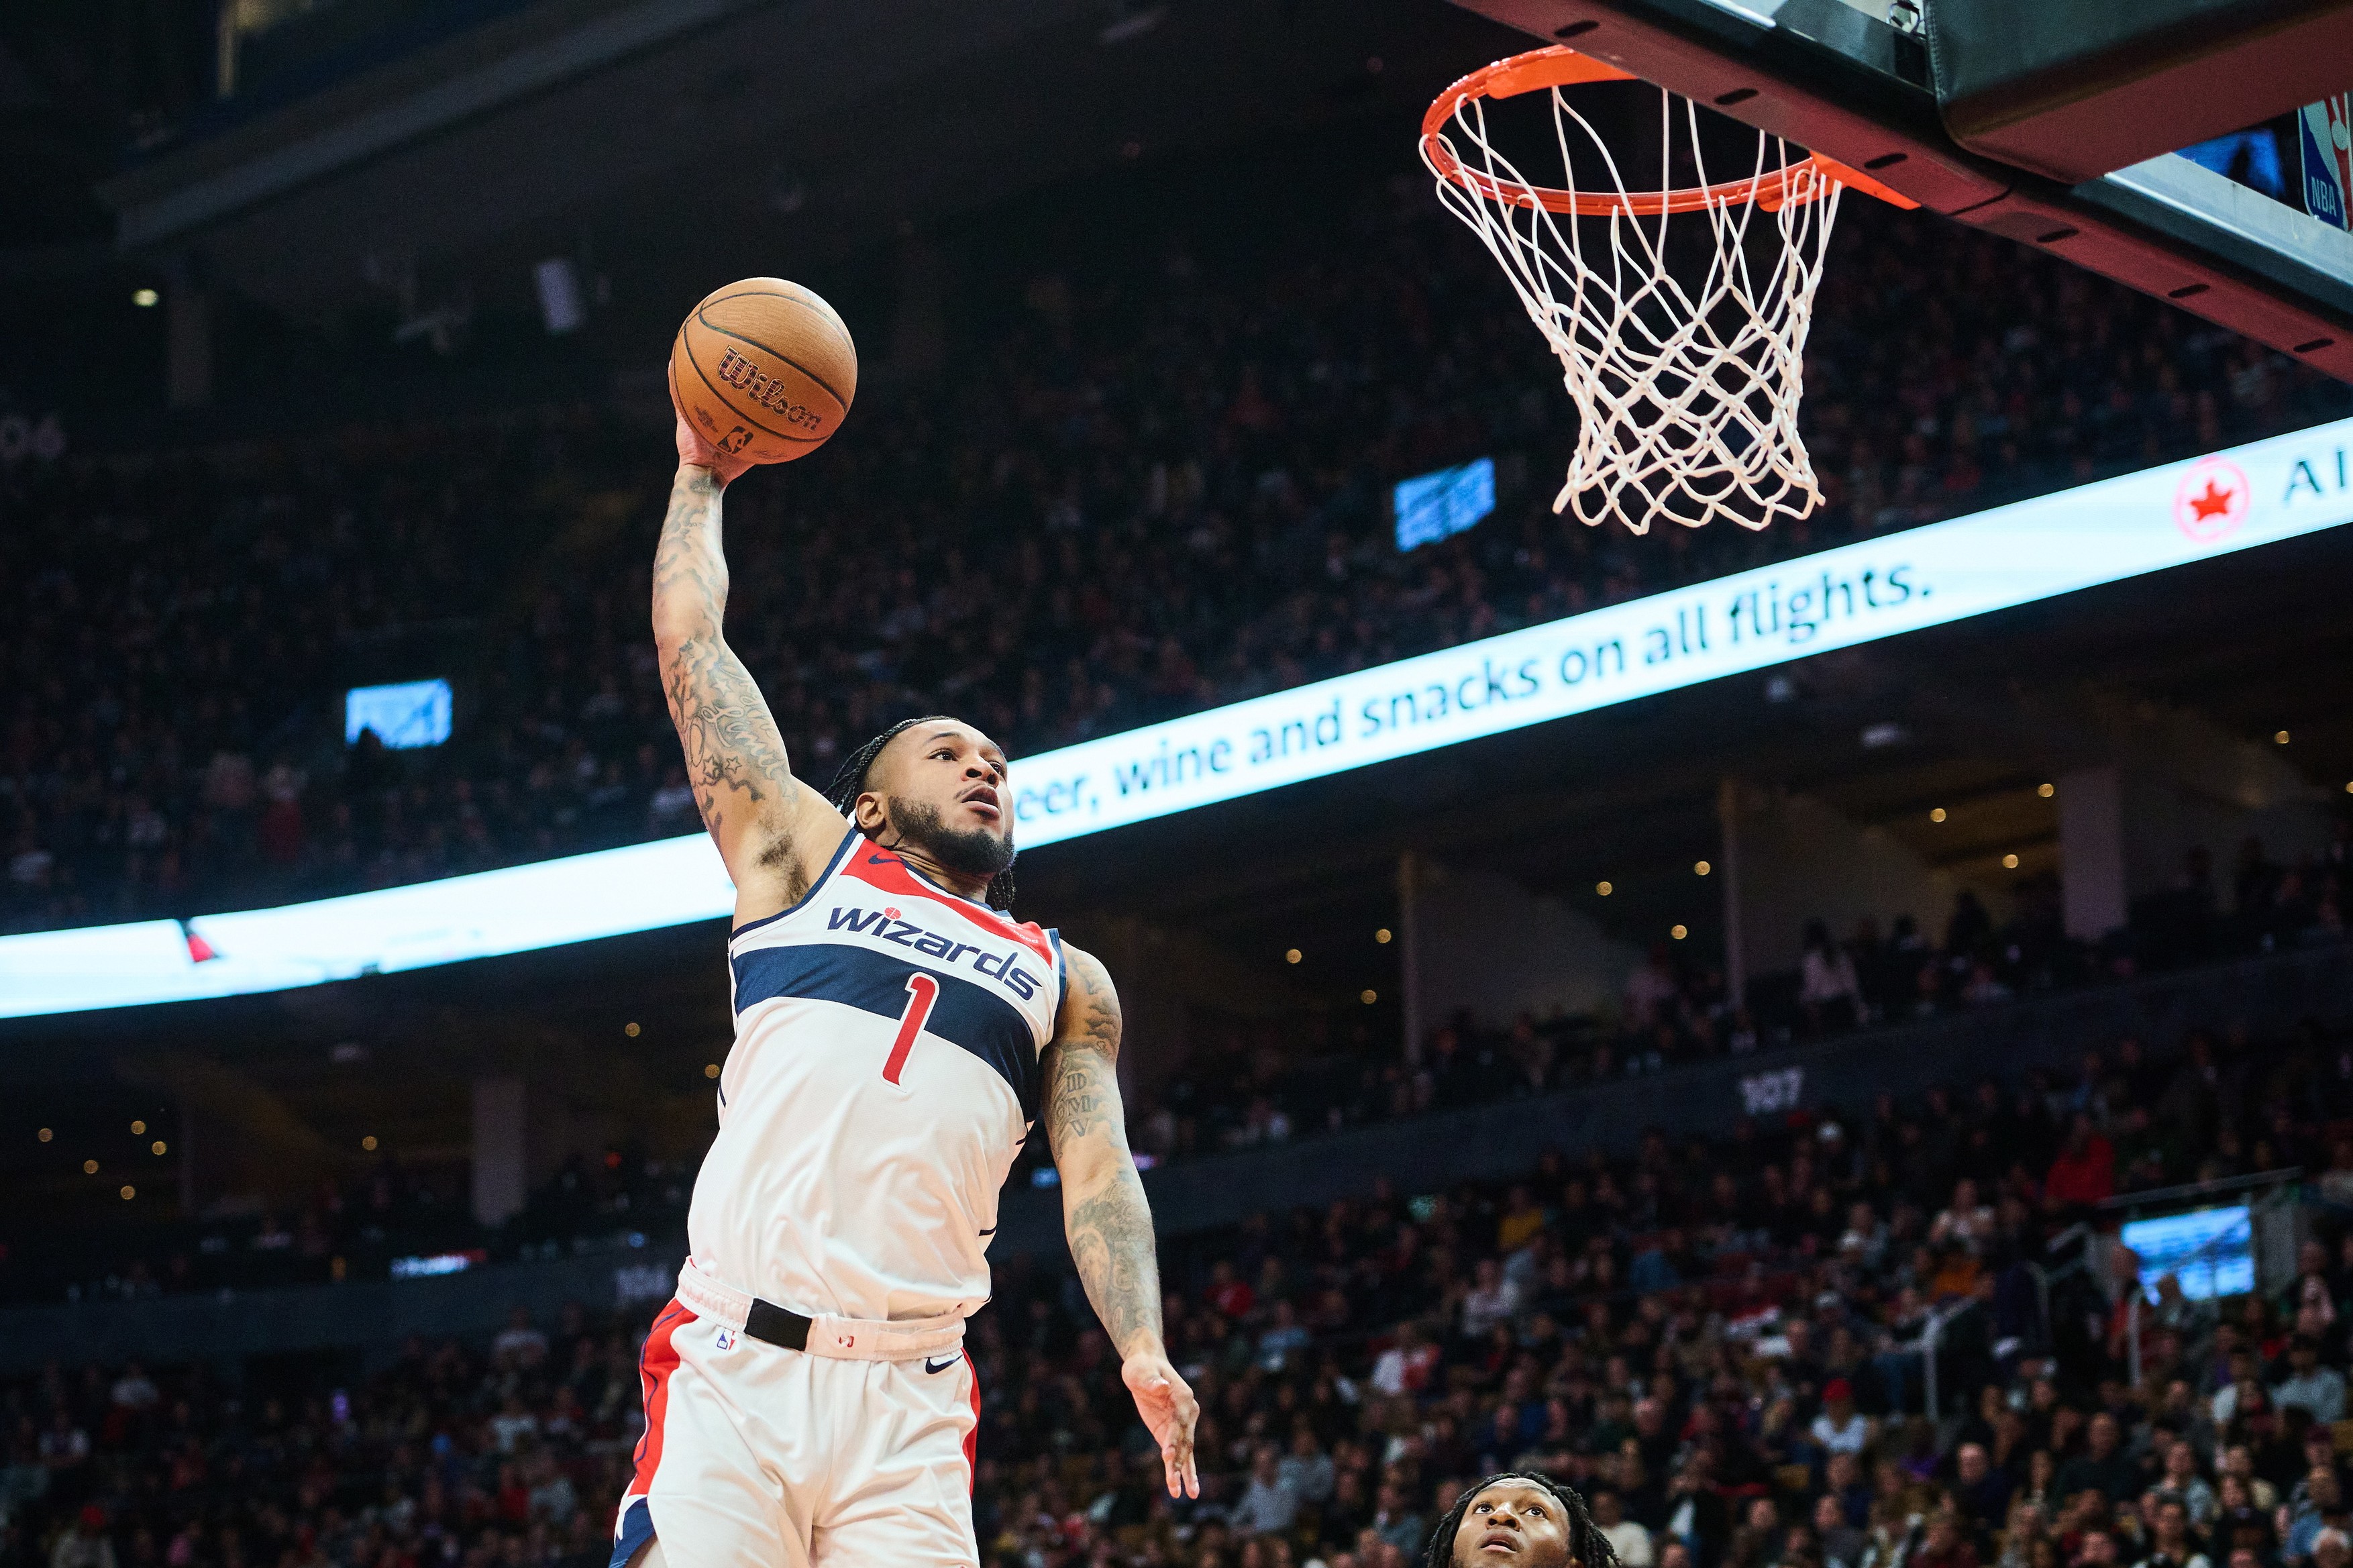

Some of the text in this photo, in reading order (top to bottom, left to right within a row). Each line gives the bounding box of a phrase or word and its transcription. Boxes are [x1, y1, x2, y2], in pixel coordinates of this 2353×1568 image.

[2311, 176, 2337, 217] NBA
[717, 345, 822, 432] Wilson
[1016, 564, 1932, 815] eer, wine and snacks on all flights.
[827, 906, 1043, 1002] wizards
[882, 975, 937, 1088] 1
